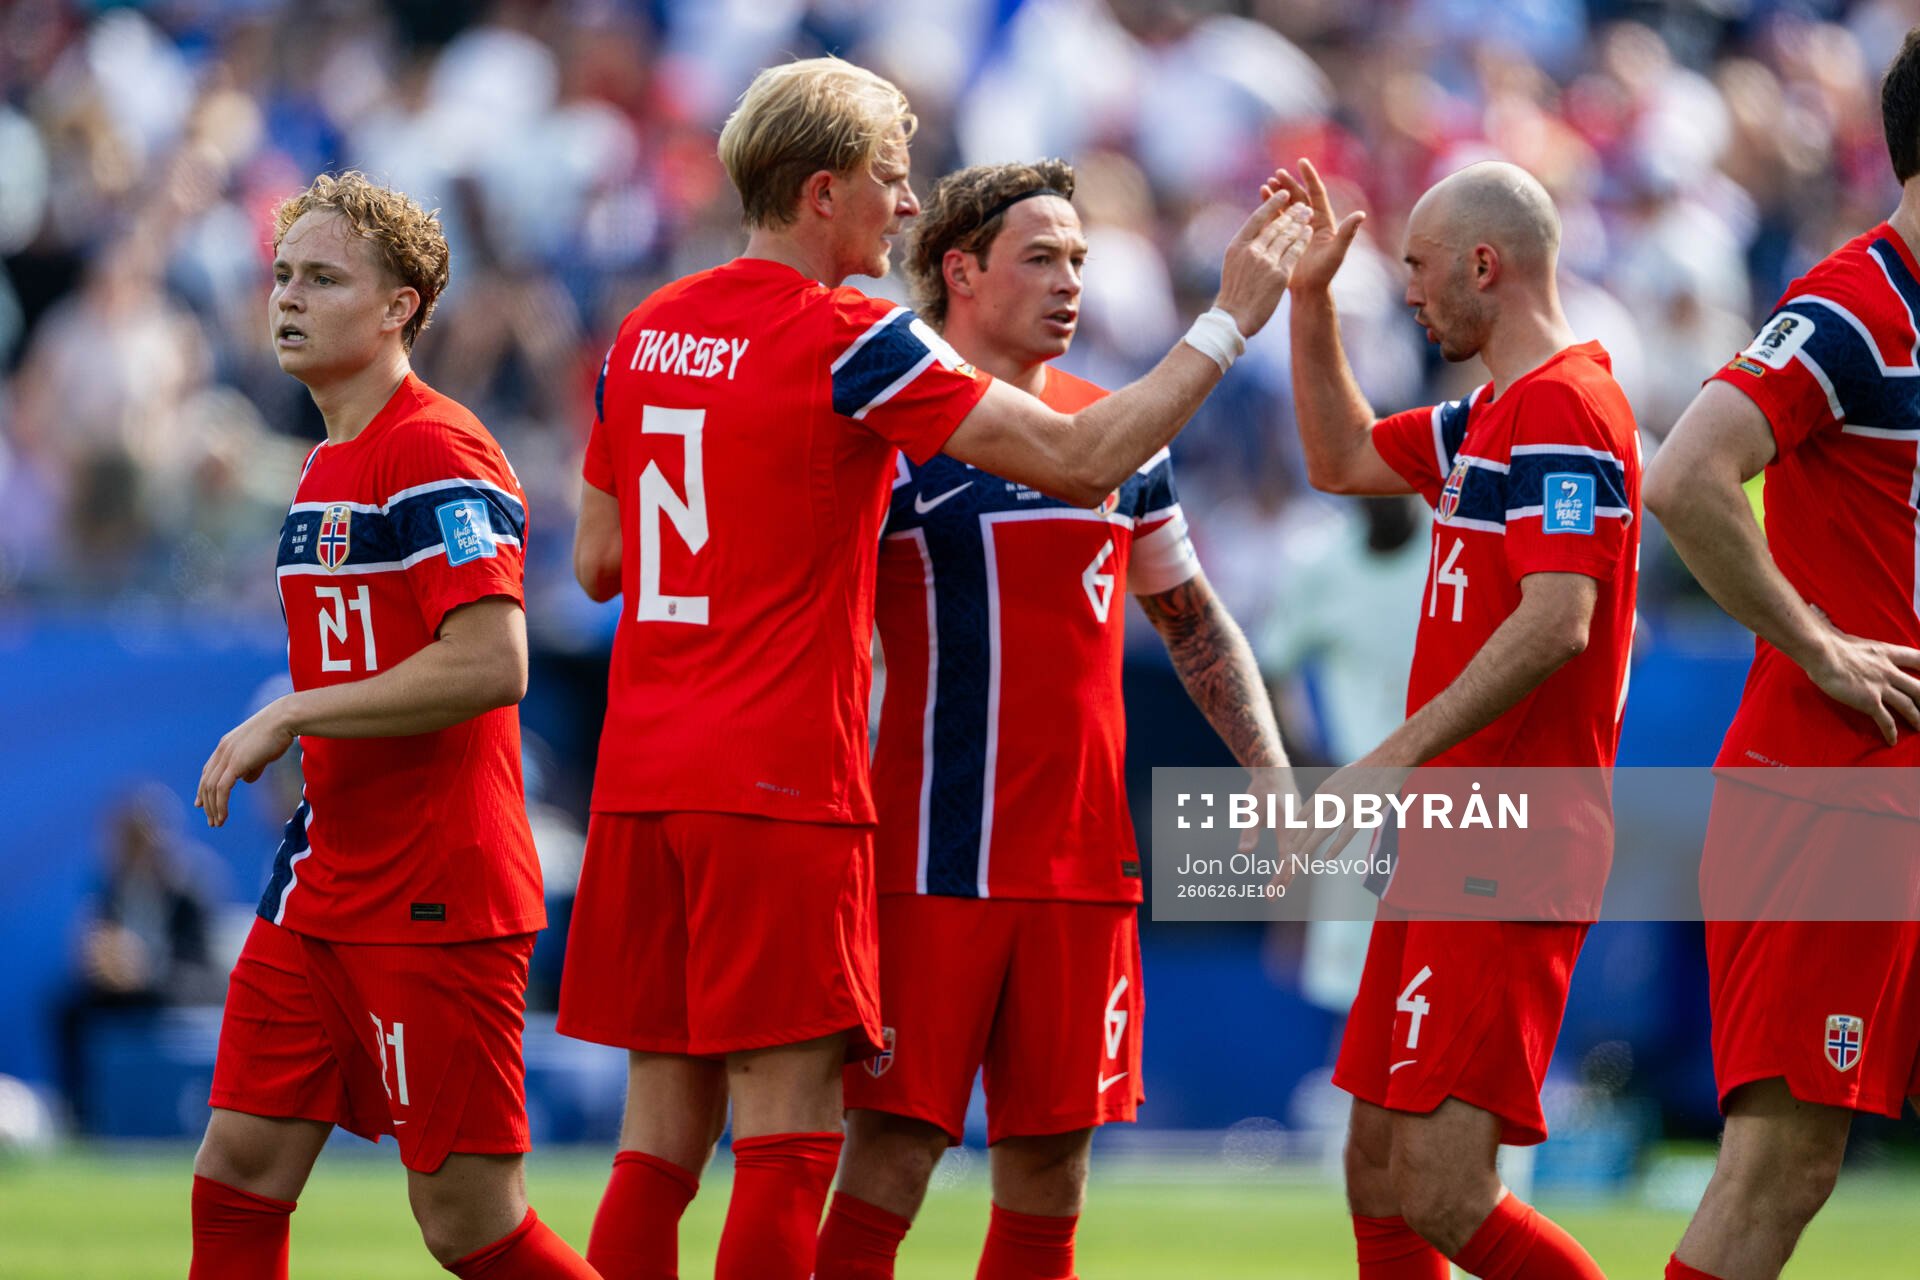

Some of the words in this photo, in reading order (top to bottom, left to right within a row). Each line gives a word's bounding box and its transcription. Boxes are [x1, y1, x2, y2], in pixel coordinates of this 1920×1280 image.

[630, 329, 750, 380] THORSBY
[637, 404, 709, 626] 2
[1556, 510, 1581, 521] PEACE
[1082, 538, 1115, 624] 6
[1428, 532, 1469, 623] 14
[315, 585, 378, 672] 21
[1104, 974, 1129, 1060] 6
